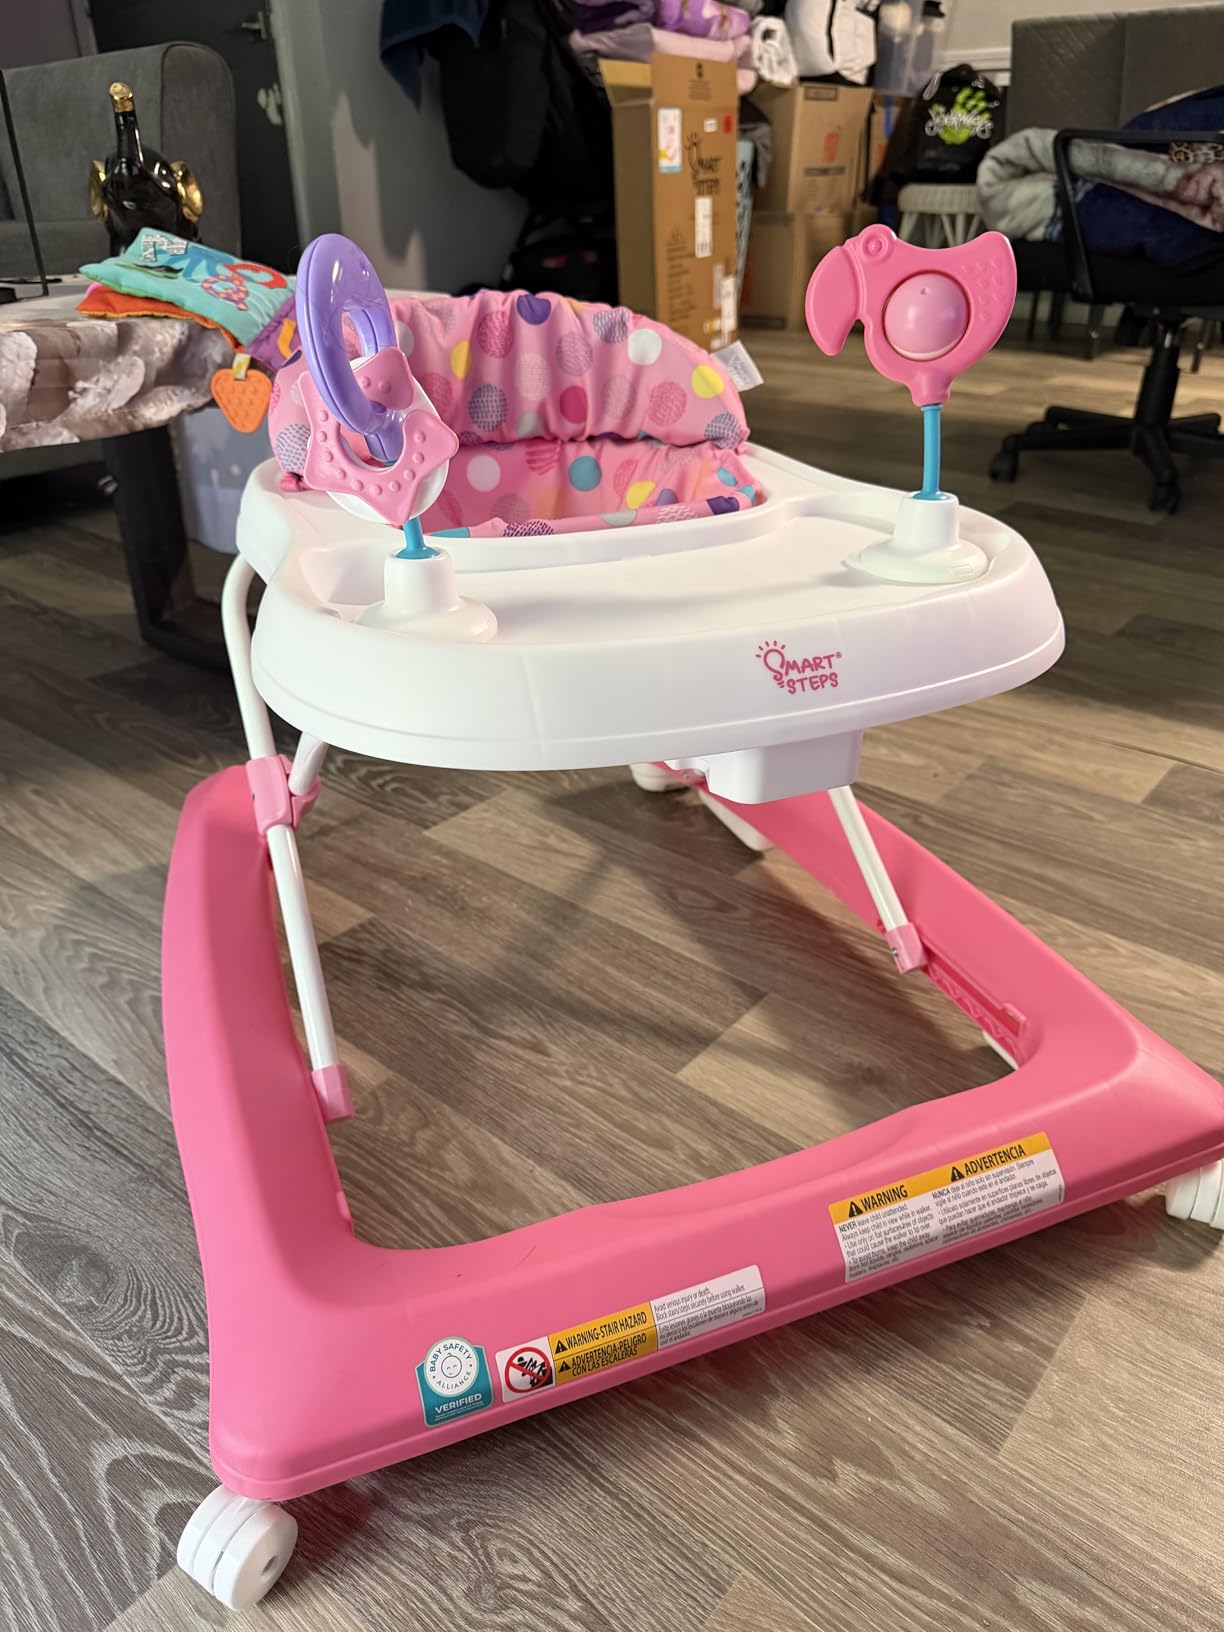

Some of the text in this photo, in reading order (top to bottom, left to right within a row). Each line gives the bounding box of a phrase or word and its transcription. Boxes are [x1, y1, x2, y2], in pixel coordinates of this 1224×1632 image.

[786, 672, 838, 694] STEPS
[964, 1144, 1026, 1175] ADVERTENCIA
[861, 1185, 908, 1211] WARNING
[931, 1187, 950, 1199] NUNCA
[838, 1221, 857, 1232] NEVER
[566, 1311, 647, 1349] WARNING-STAIR HAZARD
[429, 1343, 472, 1372] BABY SAFETY
[572, 1333, 646, 1366] ADVERTENCIA-PELIGRO
[572, 1346, 637, 1376] CON LAS ESCALERAS
[436, 1370, 471, 1389] ALLIANCE
[434, 1393, 482, 1413] VERIFIED
